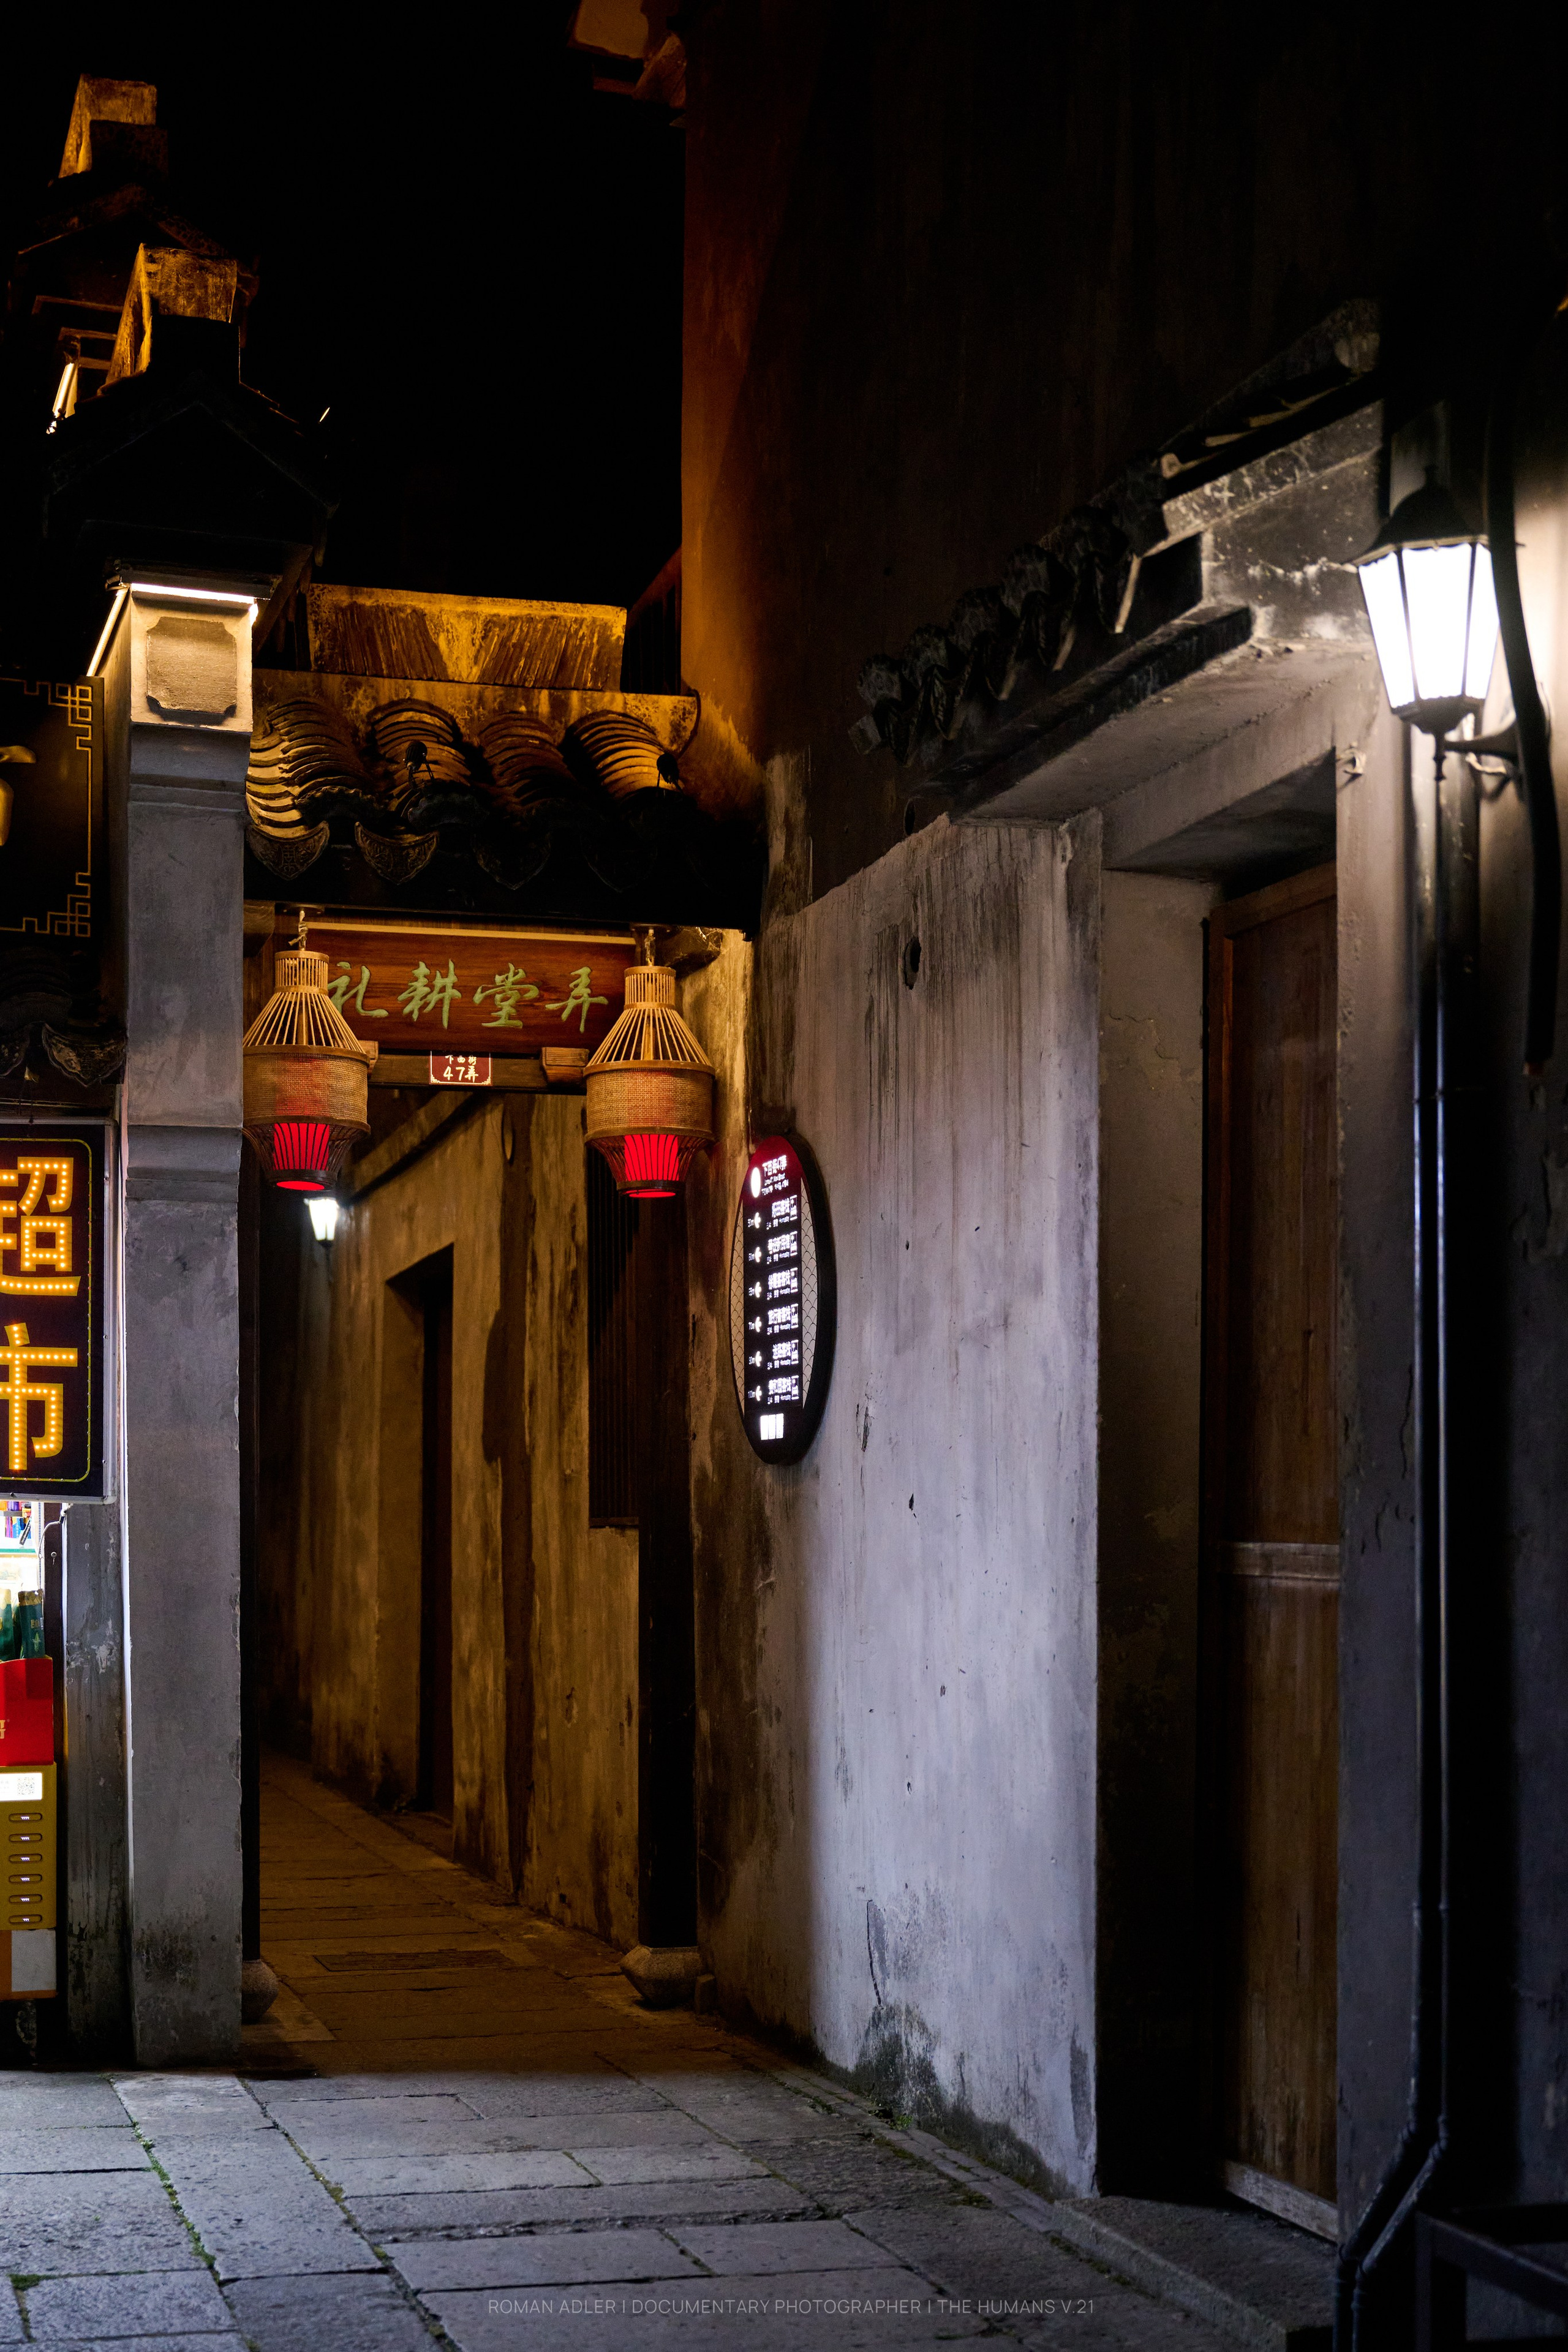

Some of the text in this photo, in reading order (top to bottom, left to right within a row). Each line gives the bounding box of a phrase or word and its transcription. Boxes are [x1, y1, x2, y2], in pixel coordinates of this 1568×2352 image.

[327, 959, 609, 1034] 礼耕堂弄
[443, 1065, 479, 1083] 47弄
[445, 1055, 477, 1065] 下西街
[0, 1157, 81, 1471] 超市
